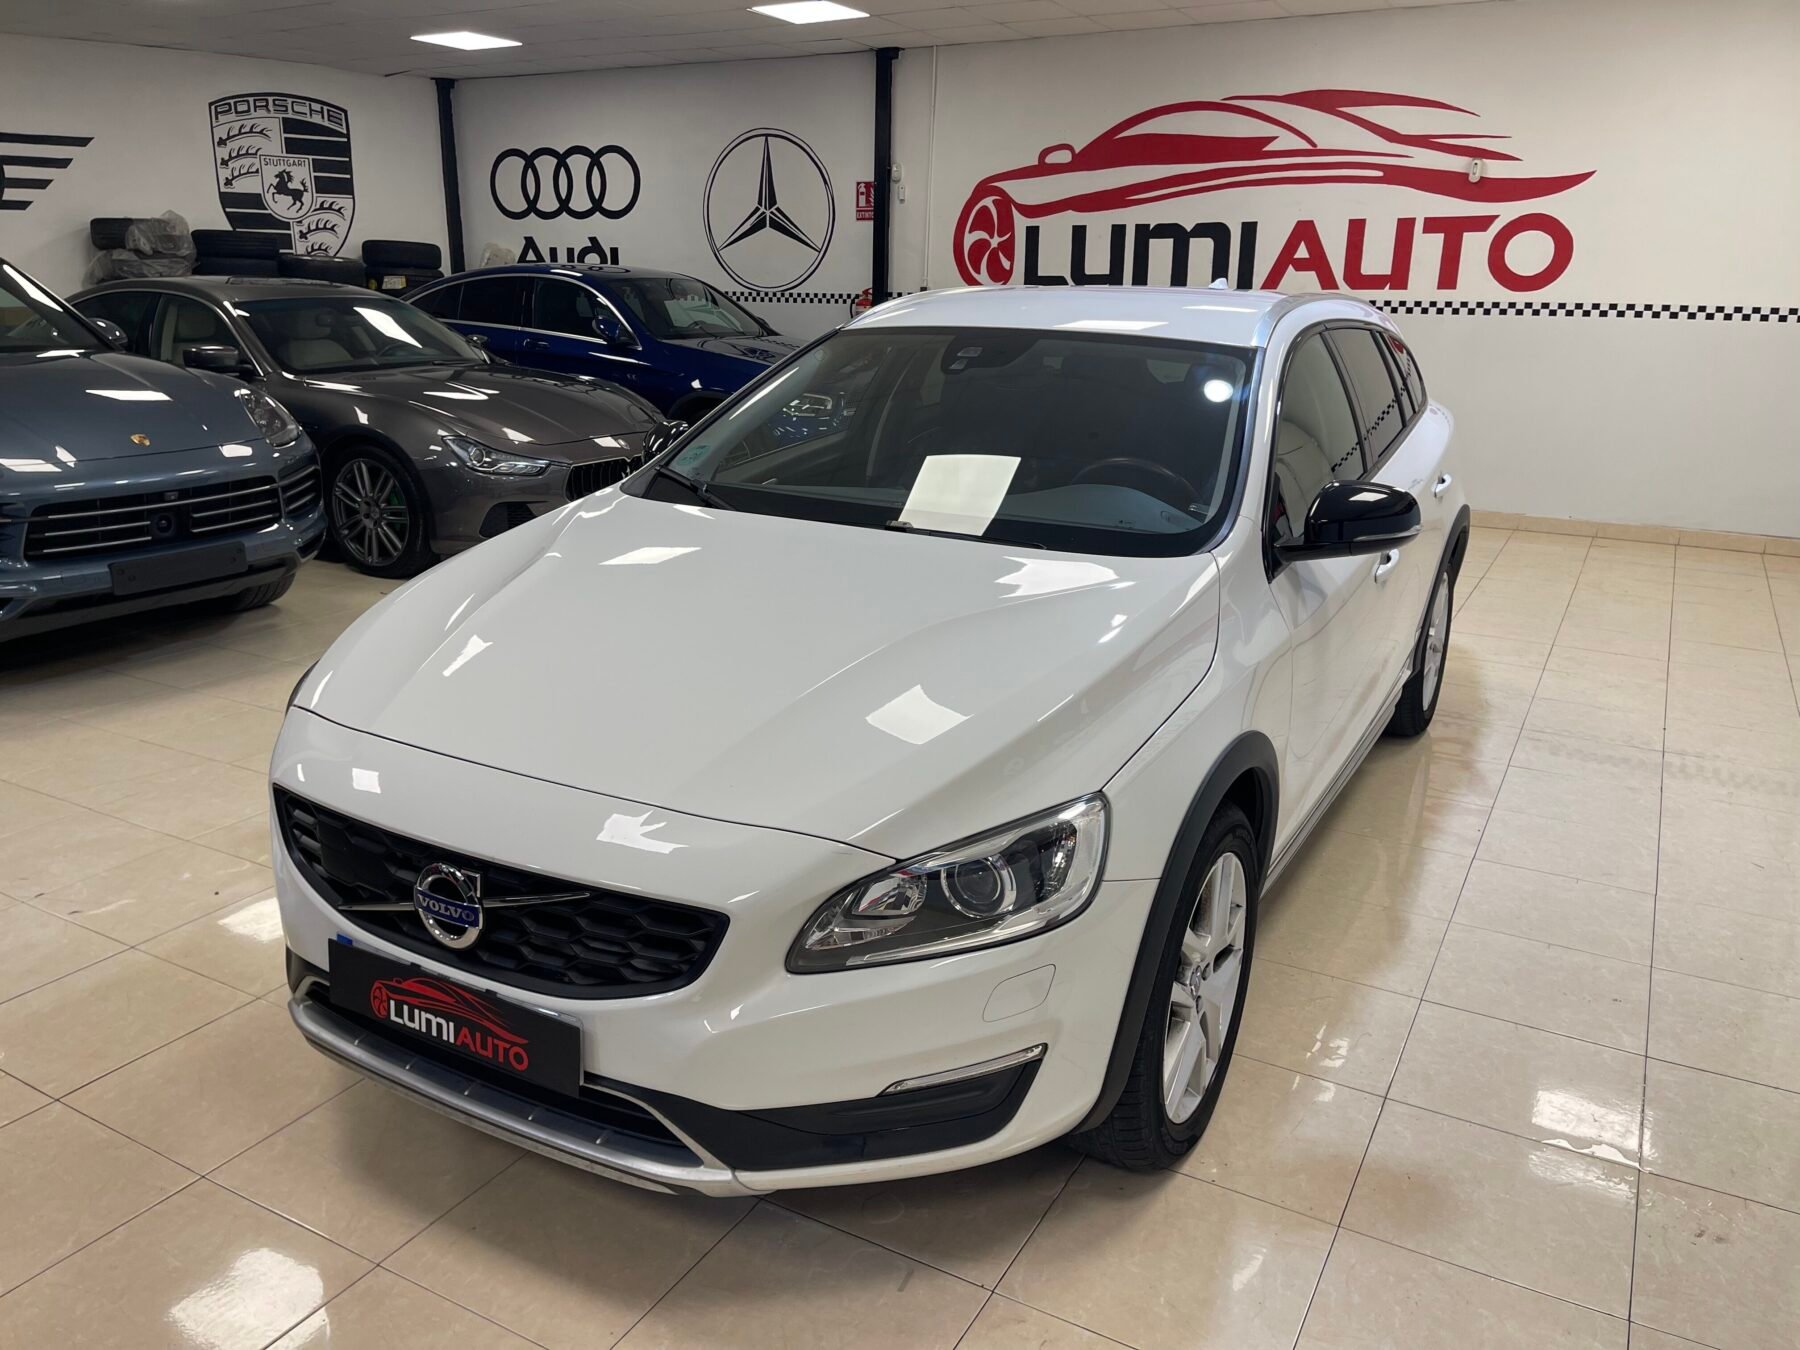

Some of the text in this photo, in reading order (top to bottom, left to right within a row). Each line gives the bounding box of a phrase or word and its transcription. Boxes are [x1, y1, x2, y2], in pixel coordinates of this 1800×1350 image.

[214, 98, 345, 130] PORSCHE
[263, 157, 307, 168] STUTTGART
[516, 236, 620, 266] Audi
[417, 893, 475, 922] VOLVO
